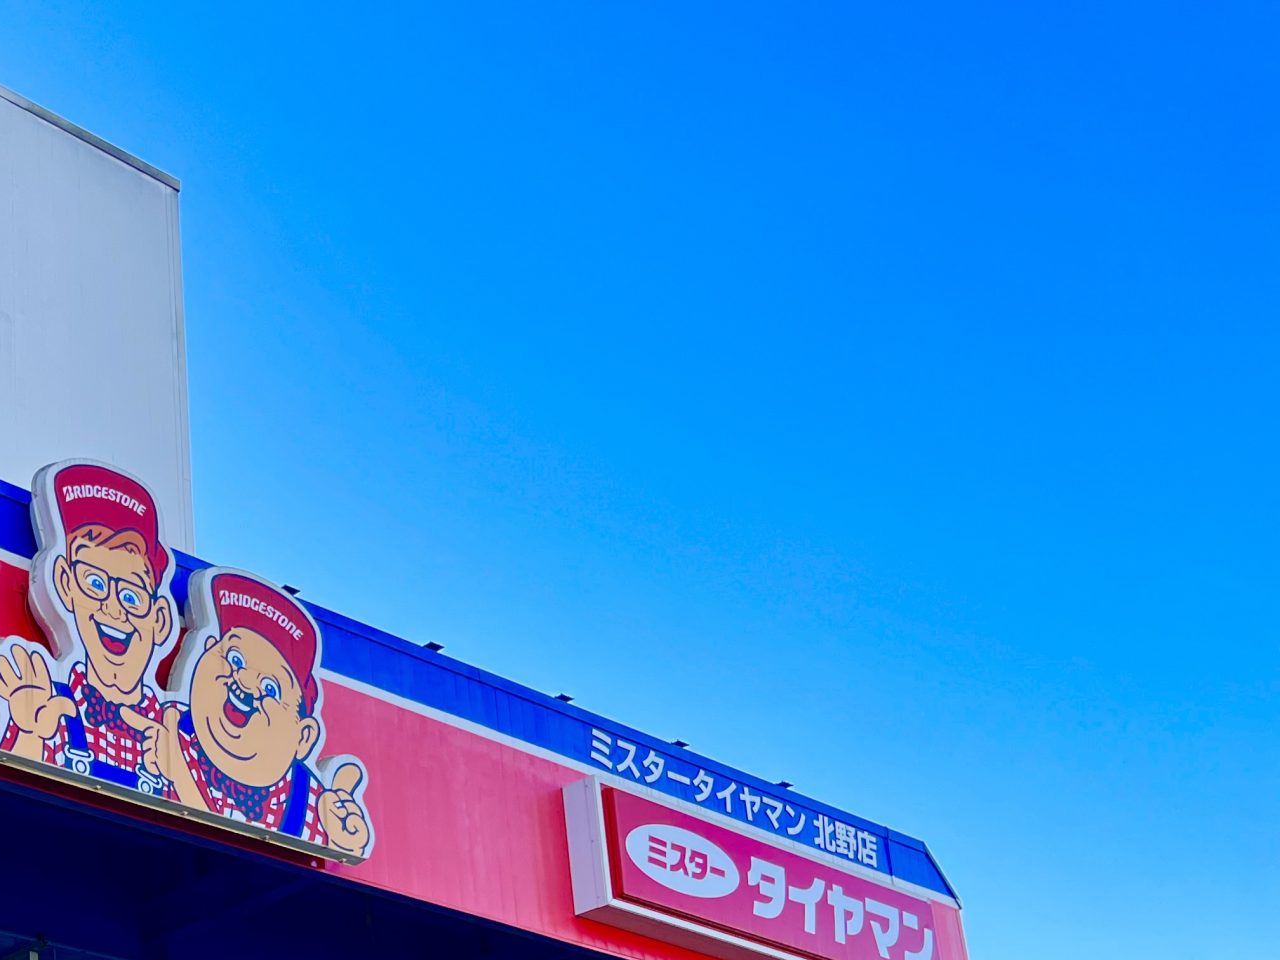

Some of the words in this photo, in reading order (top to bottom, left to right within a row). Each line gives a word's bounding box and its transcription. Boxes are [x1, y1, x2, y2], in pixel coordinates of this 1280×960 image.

[62, 485, 147, 517] BRIDGESTONE
[219, 589, 304, 642] BRIDGESTONE
[590, 728, 806, 836] ミスタータイヤマン
[813, 813, 878, 868] 北野店
[647, 835, 726, 880] ミスター
